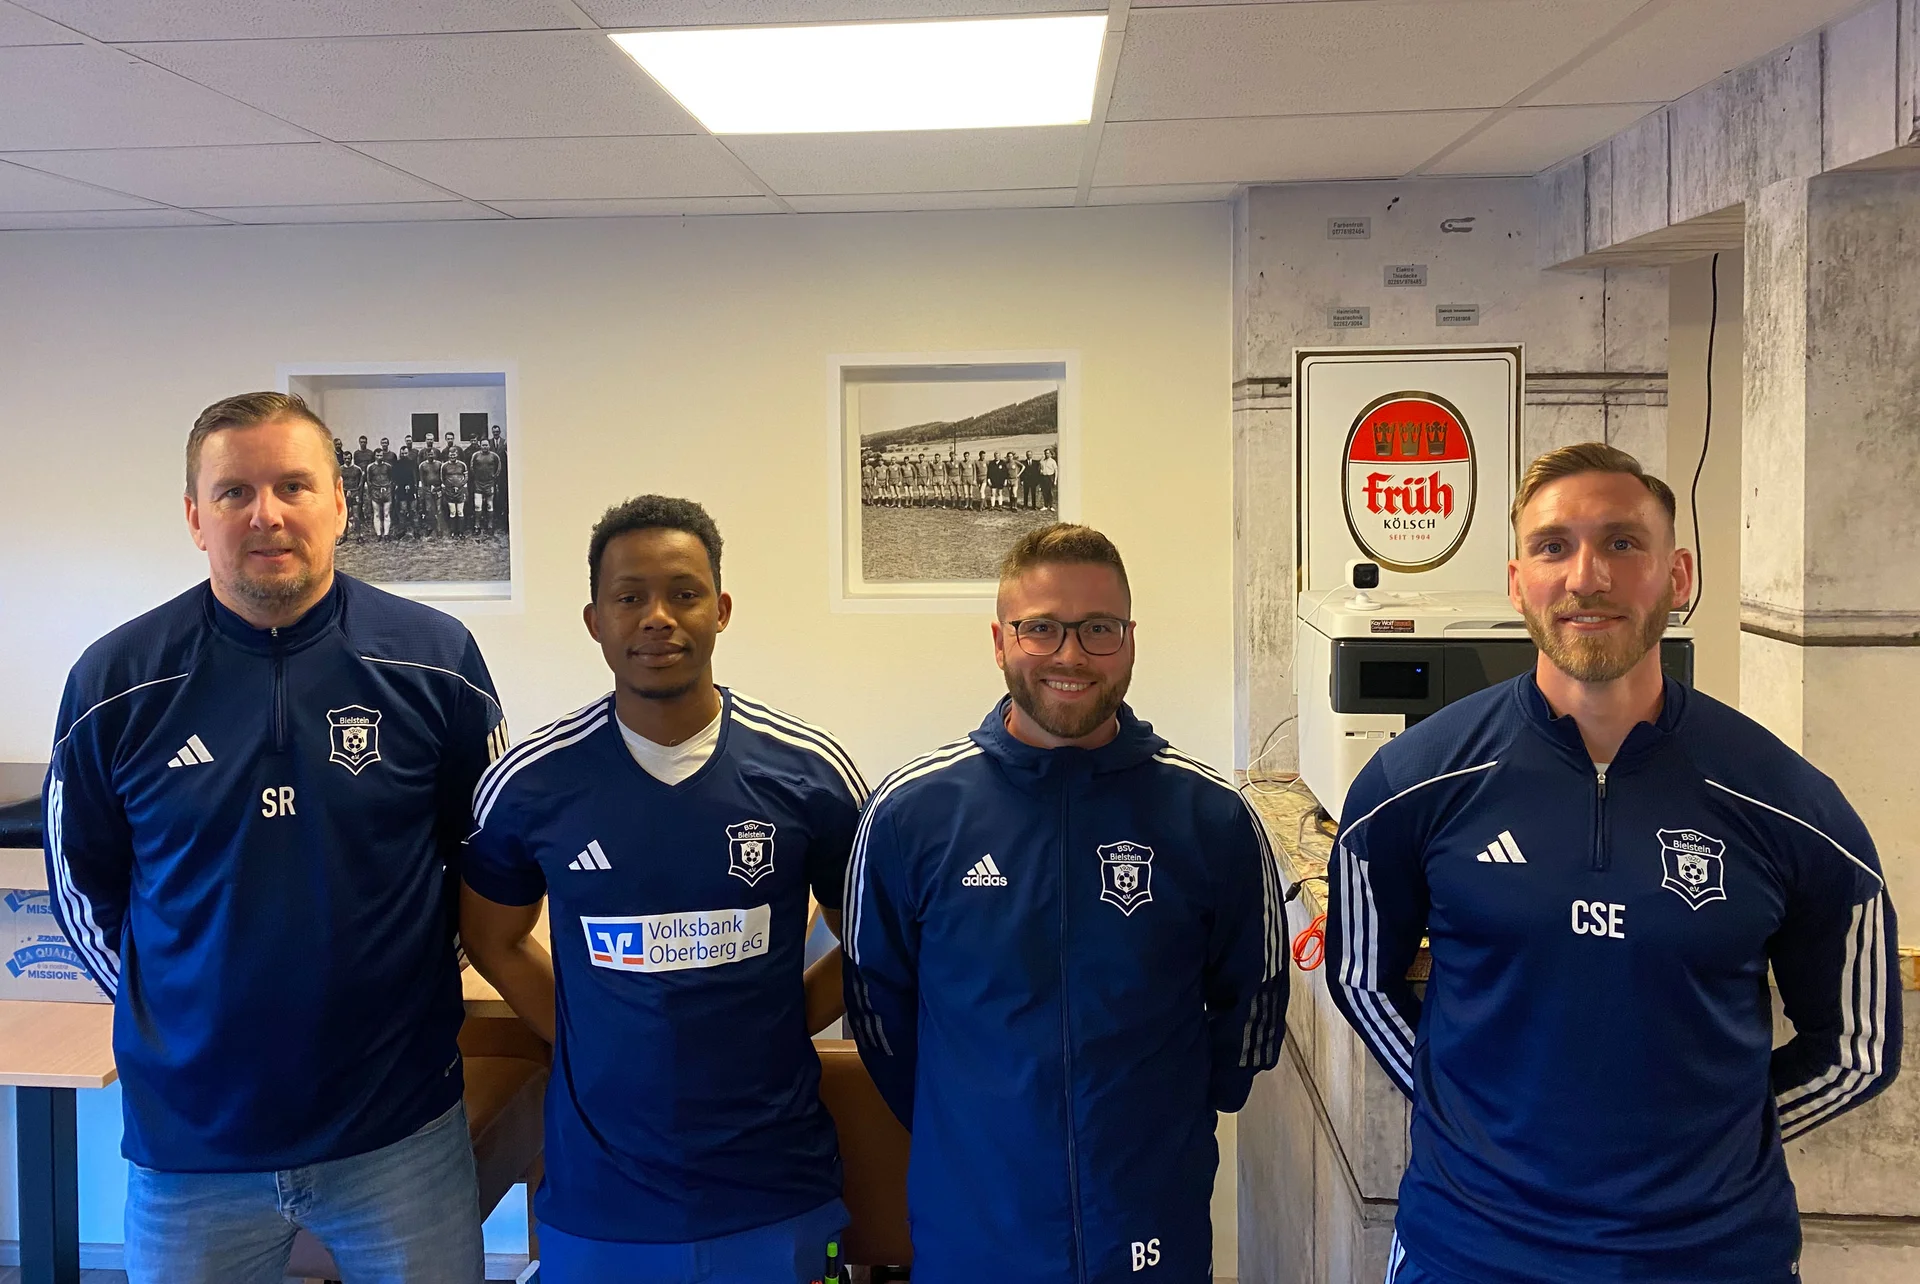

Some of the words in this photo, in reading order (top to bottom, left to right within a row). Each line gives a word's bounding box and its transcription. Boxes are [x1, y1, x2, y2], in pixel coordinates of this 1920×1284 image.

[1383, 517, 1436, 530] KÖLSCH
[339, 716, 370, 725] Bielstein
[261, 786, 297, 818] SR
[744, 823, 760, 831] BSV
[737, 831, 766, 839] Bielstein
[1681, 833, 1702, 842] BSV
[1116, 844, 1135, 853] BSV
[1673, 840, 1711, 854] Bielstein
[1110, 852, 1142, 861] Bielstein
[961, 874, 1008, 887] adidas
[26, 904, 53, 914] MISS
[1571, 899, 1626, 939] CSE
[648, 914, 743, 940] Volksbank
[649, 940, 736, 965] Oberberg
[742, 932, 763, 953] eG
[18, 951, 33, 963] LA
[27, 969, 78, 980] MISSIONE
[1131, 1237, 1161, 1272] BS
